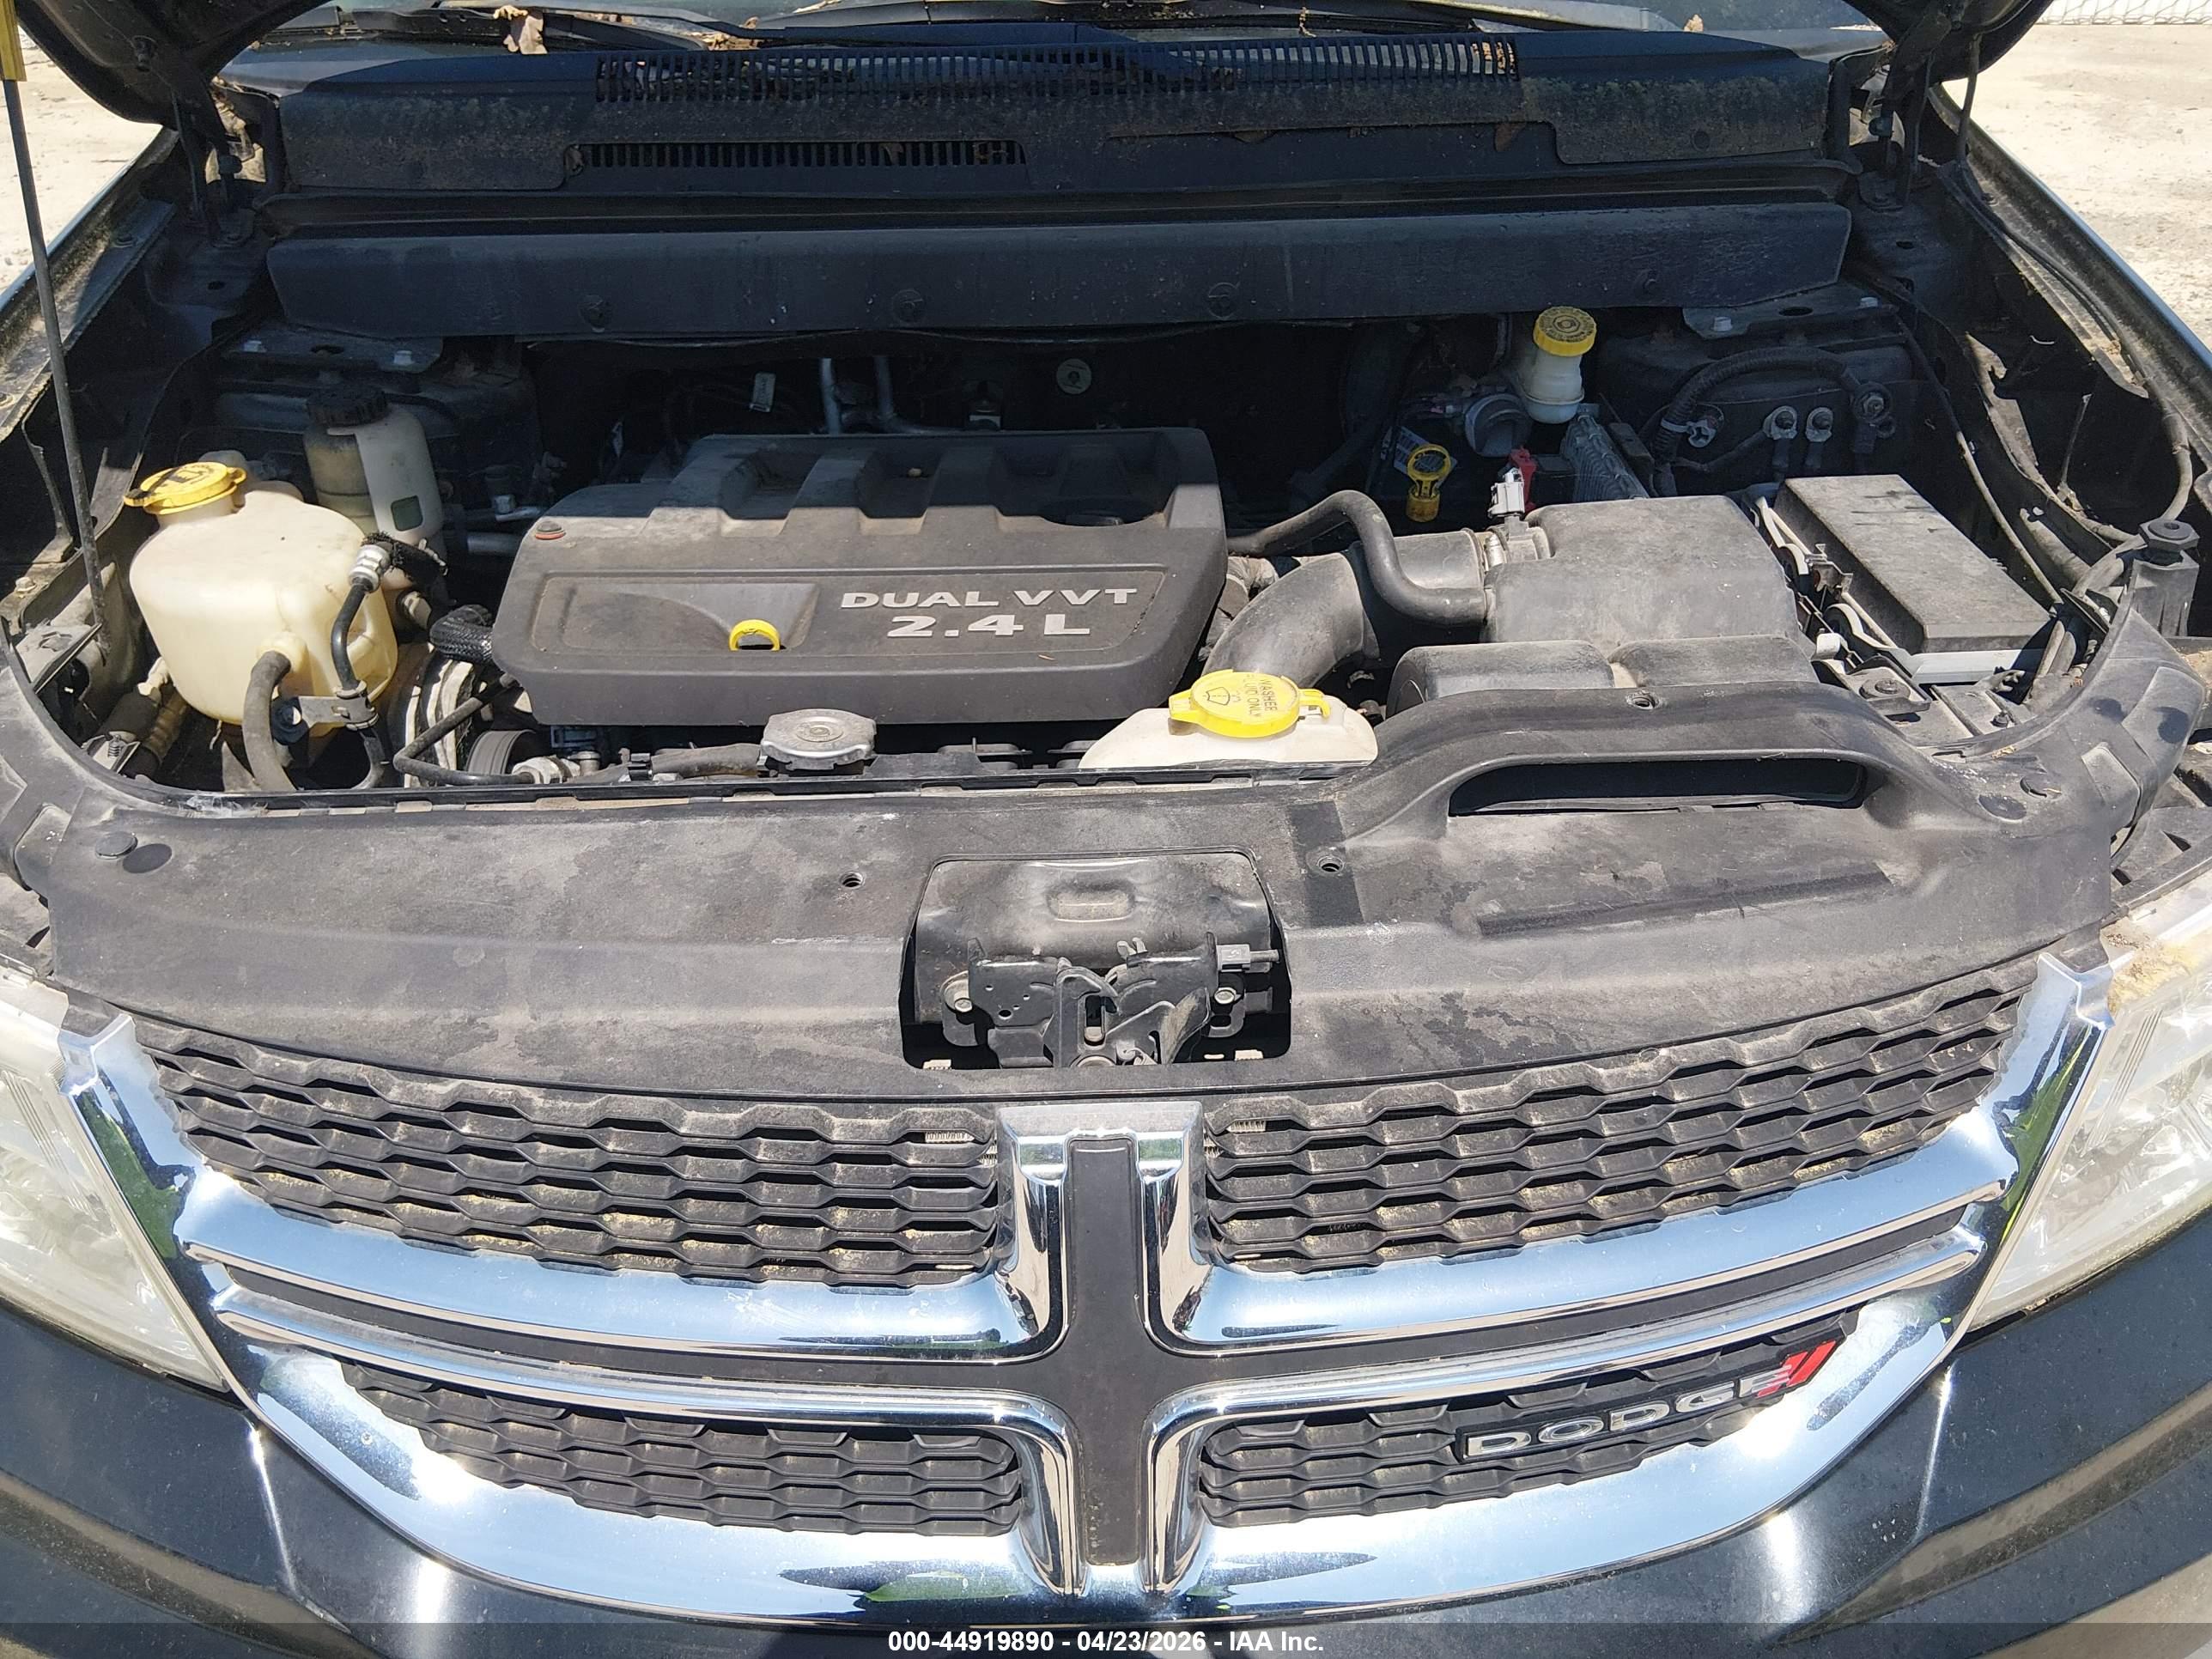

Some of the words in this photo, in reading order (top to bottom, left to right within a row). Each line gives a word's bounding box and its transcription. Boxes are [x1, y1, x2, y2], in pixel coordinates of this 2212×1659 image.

[841, 591, 1000, 608] DUAL
[1012, 587, 1138, 606] VVT
[886, 614, 1025, 638] 2.4
[1042, 613, 1091, 635] L
[1466, 1364, 1793, 1459] DODGE
